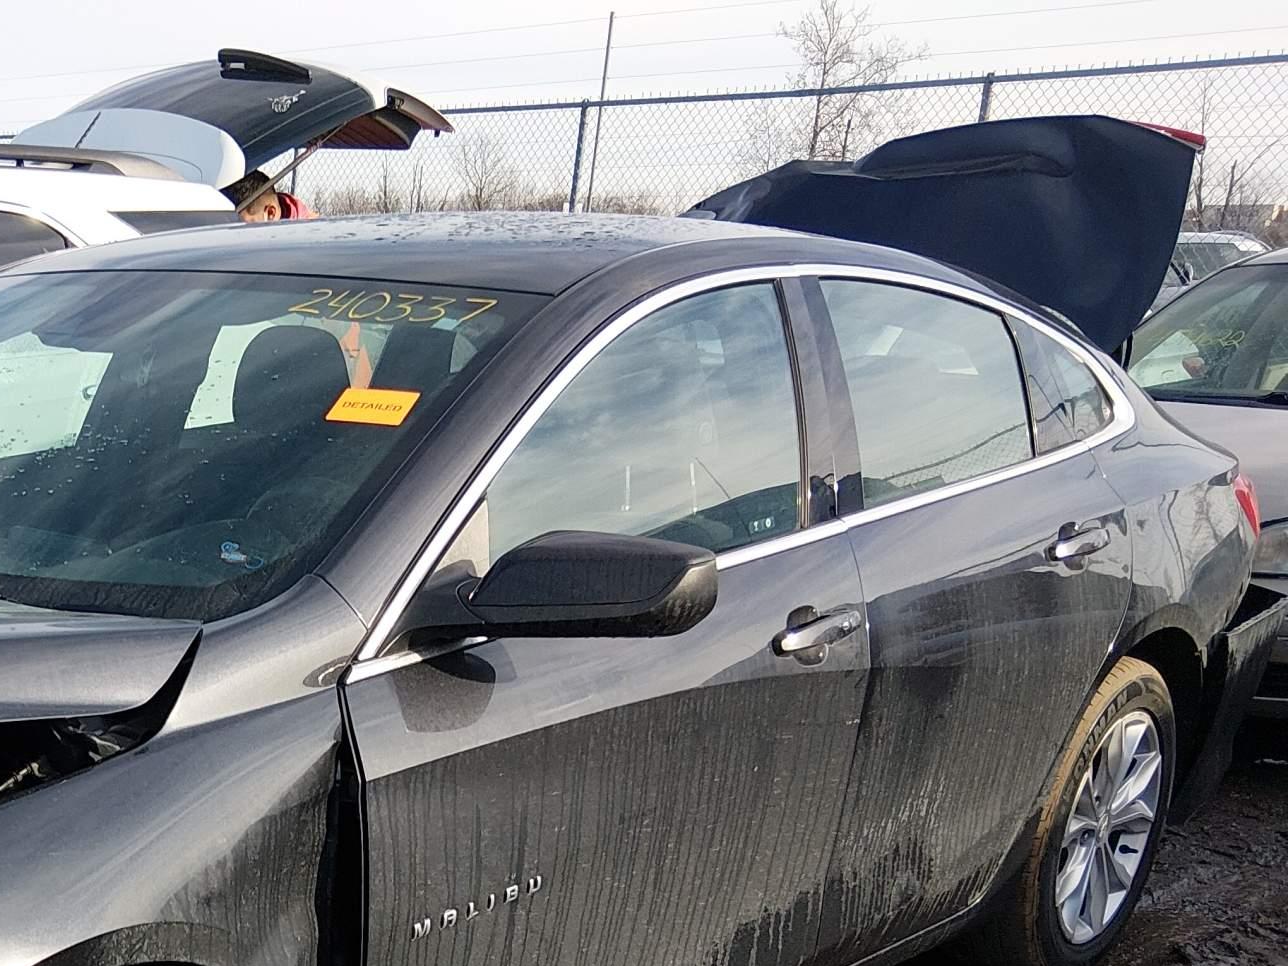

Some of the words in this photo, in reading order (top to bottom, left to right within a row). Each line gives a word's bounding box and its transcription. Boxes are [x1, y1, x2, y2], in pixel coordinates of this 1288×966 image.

[287, 288, 499, 323] 240337
[341, 400, 402, 413] DETAILED
[411, 874, 542, 941] MALIBU
